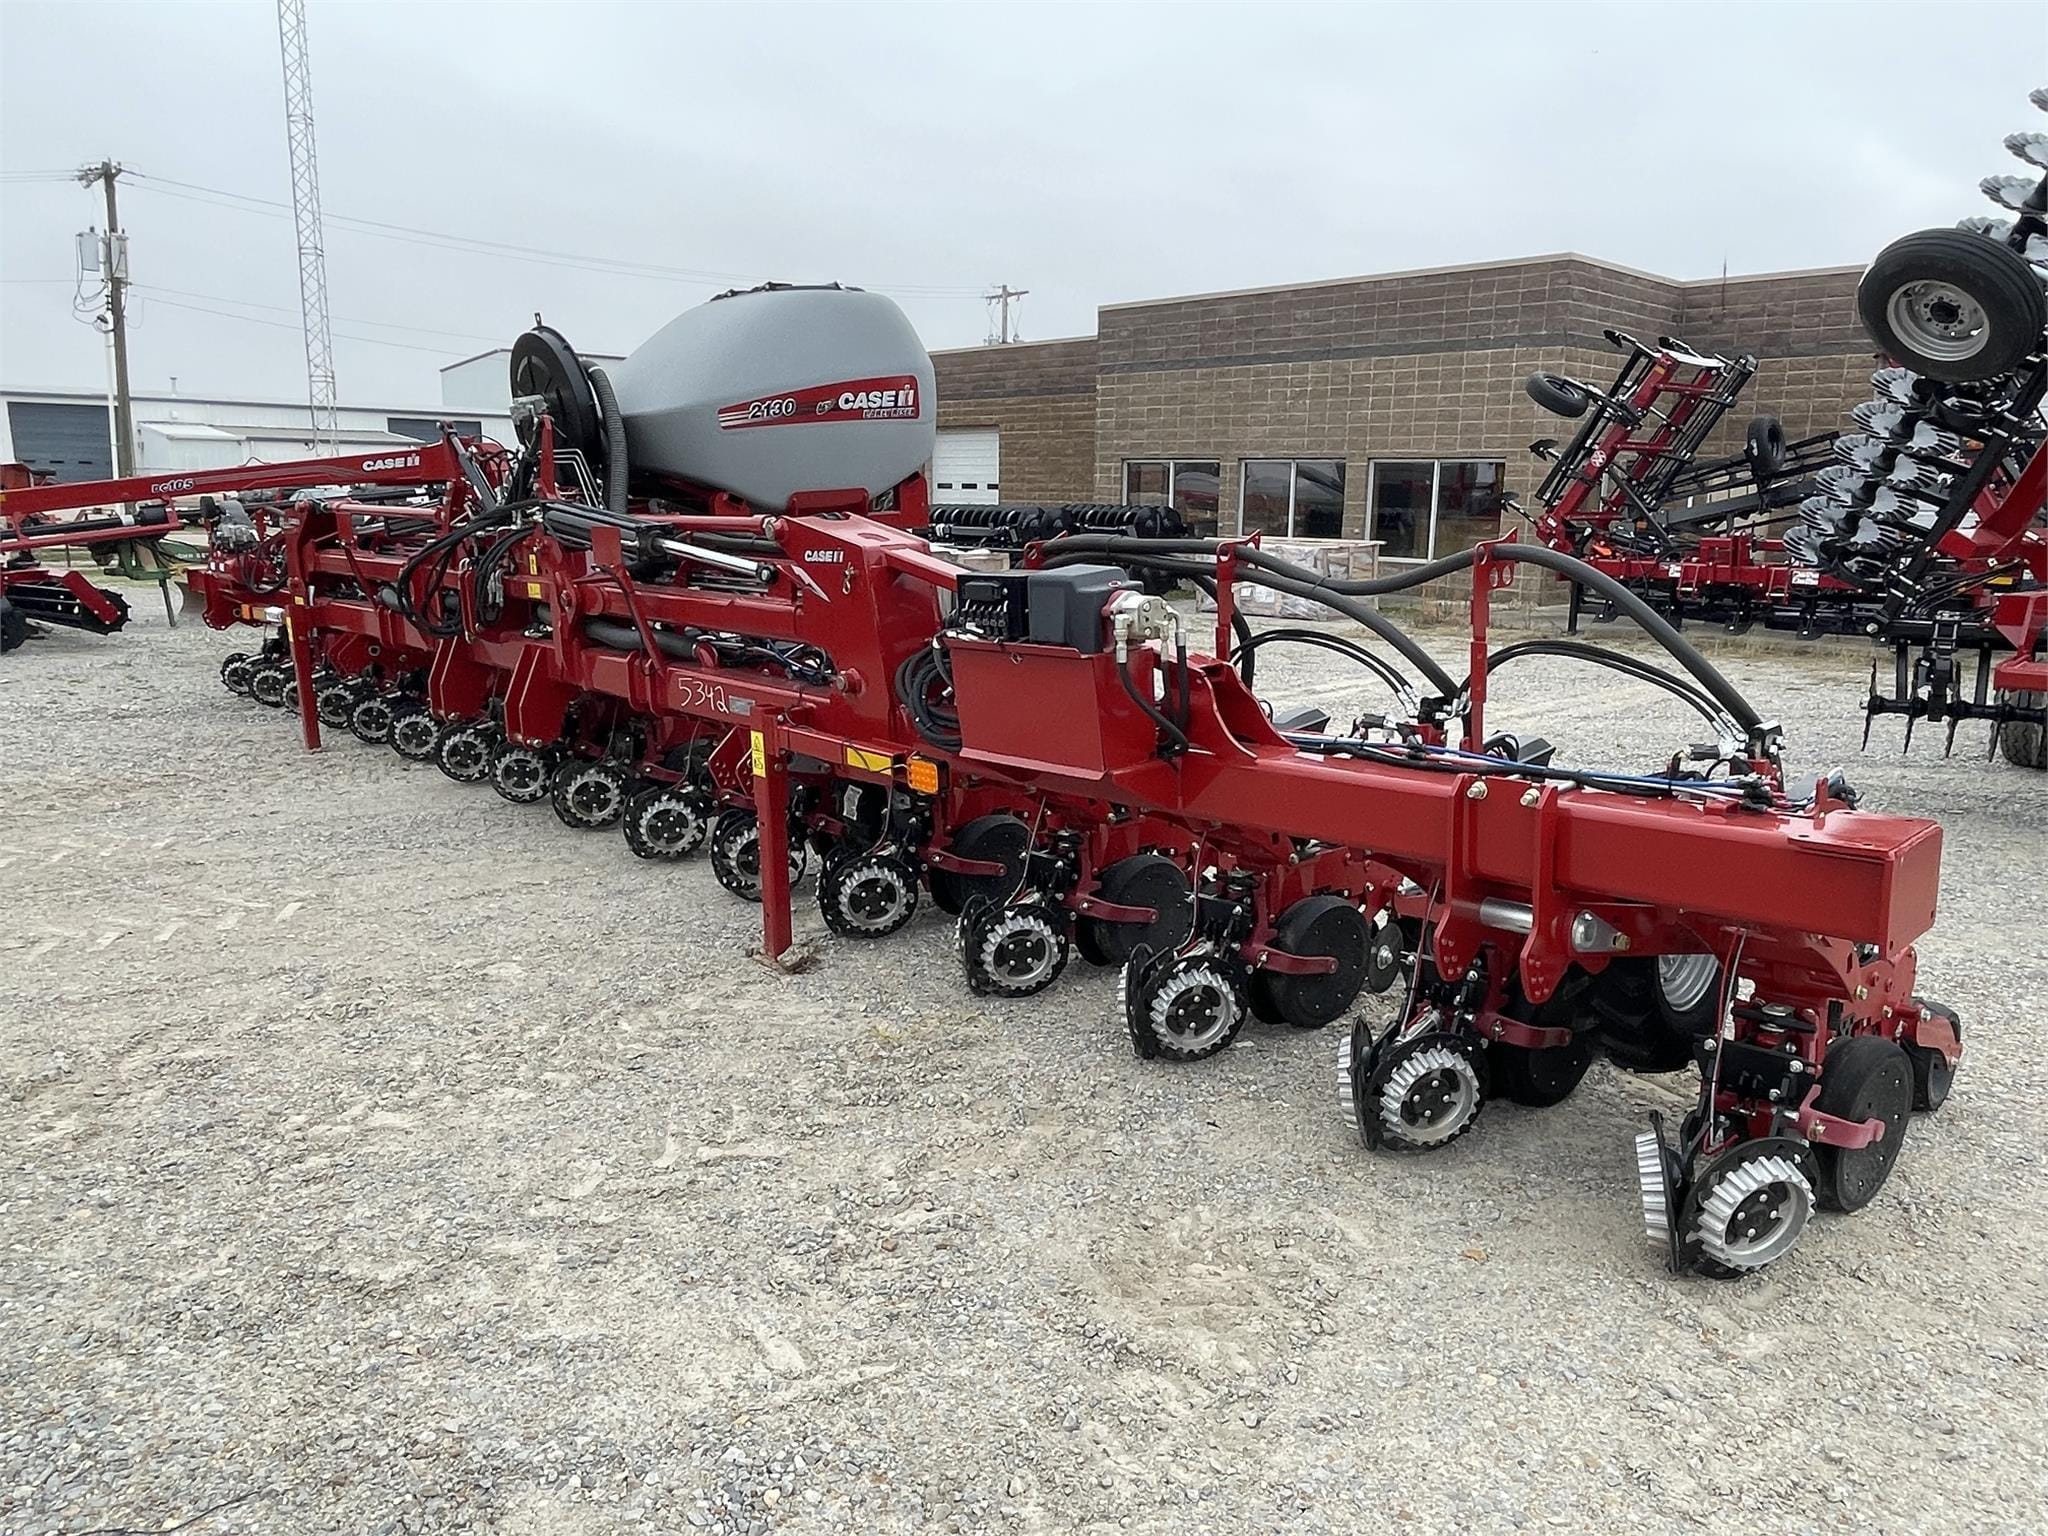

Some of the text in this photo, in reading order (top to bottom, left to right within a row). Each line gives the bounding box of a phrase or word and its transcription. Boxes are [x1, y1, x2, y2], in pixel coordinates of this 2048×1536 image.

[748, 398, 796, 420] 2130
[838, 390, 896, 410] CASE
[362, 457, 406, 472] CASE
[804, 550, 833, 563] CASE
[678, 678, 730, 714] 5342
